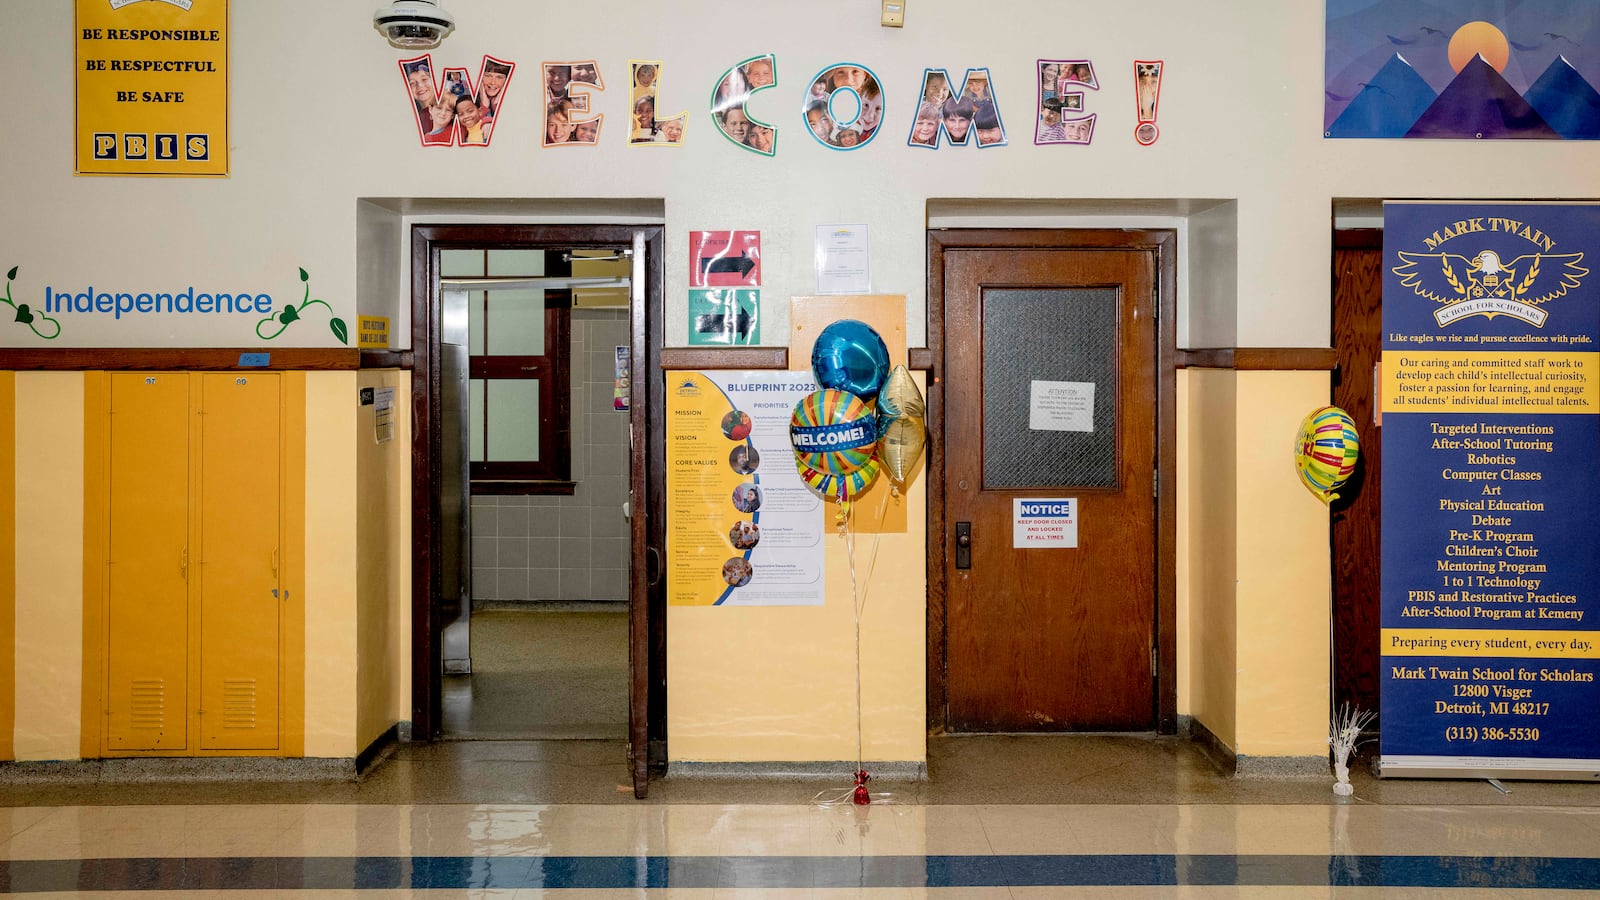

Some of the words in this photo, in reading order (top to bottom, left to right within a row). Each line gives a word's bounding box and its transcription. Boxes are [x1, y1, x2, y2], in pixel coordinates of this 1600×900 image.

[82, 29, 103, 40] BE
[107, 29, 220, 42] RESPONSIBLE
[86, 60, 106, 71] BE
[110, 60, 216, 72] RESPECTFUL
[117, 91, 137, 102] BE
[142, 92, 184, 103] SAFE
[398, 54, 1164, 157] WELCOME!
[95, 134, 208, 159] PBIS
[1422, 217, 1487, 252] MARK
[1487, 217, 1557, 253] TWAIN
[45, 286, 272, 320] Independence
[1441, 303, 1473, 321] SCHOOL
[1476, 301, 1495, 309] FOR
[1495, 301, 1541, 321] SCHOLARS
[1390, 333, 1408, 341] Like
[1410, 334, 1433, 343] eagles
[1448, 334, 1463, 343] rise
[1464, 334, 1479, 342] and
[1480, 336, 1507, 344] pursue
[1509, 335, 1548, 343] excellence
[1551, 334, 1570, 343] with
[1570, 334, 1593, 344] pride.
[1399, 358, 1419, 366] Our
[1421, 359, 1450, 368] caring
[1452, 359, 1469, 367] and
[1471, 358, 1522, 367] committed
[1524, 359, 1546, 367] staff
[1548, 359, 1572, 367] work
[1396, 371, 1432, 381] develop
[1434, 371, 1455, 379] each
[1457, 371, 1488, 379] child's
[1490, 371, 1543, 380] intellectual
[1545, 371, 1587, 382] curiosity,
[727, 383, 787, 392] BLUEPRINT
[790, 383, 816, 392] 2023
[1399, 383, 1426, 391] foster
[1436, 384, 1470, 394] passion
[1472, 384, 1486, 392] for
[1489, 384, 1531, 394] learning,
[1534, 384, 1551, 392] and
[1553, 386, 1585, 395] engage
[1393, 396, 1405, 404] all
[1407, 396, 1449, 404] students'
[1452, 396, 1499, 404] individual
[1502, 396, 1554, 405] intellectual
[1556, 396, 1590, 405] talents.
[792, 426, 865, 446] WELCOME!
[1431, 422, 1477, 436] Targeted
[1481, 423, 1553, 435] Interventions
[1432, 438, 1501, 450] After-School
[1504, 439, 1553, 452] Tutoring
[1468, 454, 1515, 464] Robotics
[1443, 469, 1498, 482] Computer
[1501, 468, 1541, 481] Classes
[1482, 484, 1501, 496] Art
[1021, 504, 1069, 515] NOTICE
[1440, 499, 1484, 512] Physical
[1488, 500, 1544, 511] Education
[1472, 514, 1511, 526] Debate
[1450, 530, 1482, 540] Pre-K
[1486, 530, 1533, 544] Program
[1446, 545, 1502, 556] Children's
[1506, 546, 1538, 557] Choir
[1438, 560, 1495, 574] Mentoring
[1499, 560, 1546, 574] Program
[1444, 576, 1448, 586] 1
[1453, 577, 1463, 586] to
[1468, 576, 1472, 586] 1
[1476, 576, 1540, 590] Technology
[1408, 591, 1436, 601] PBIS
[1439, 591, 1458, 601] and
[1462, 591, 1523, 603] Restorative
[1527, 592, 1576, 604] Practices
[1401, 606, 1471, 617] After-School
[1474, 607, 1521, 620] Program
[1525, 609, 1535, 618] at
[1539, 608, 1584, 621] Kemeny
[1391, 636, 1448, 650] Preparing
[1451, 640, 1481, 651] every
[1485, 638, 1532, 651] student,
[1535, 641, 1567, 652] every
[1571, 639, 1592, 652] day.
[1392, 667, 1425, 679] Mark
[1429, 667, 1468, 679] Twain
[1473, 668, 1514, 680] School
[1518, 668, 1537, 680] for
[1541, 669, 1593, 681] Scholars
[1454, 685, 1489, 697] 12800
[1492, 685, 1532, 700] Visger
[1435, 701, 1485, 717] Detroit,
[1490, 702, 1509, 714] MI
[1512, 703, 1549, 715] 48217
[1446, 727, 1478, 742] (313)
[1482, 727, 1539, 741] 386-5530
